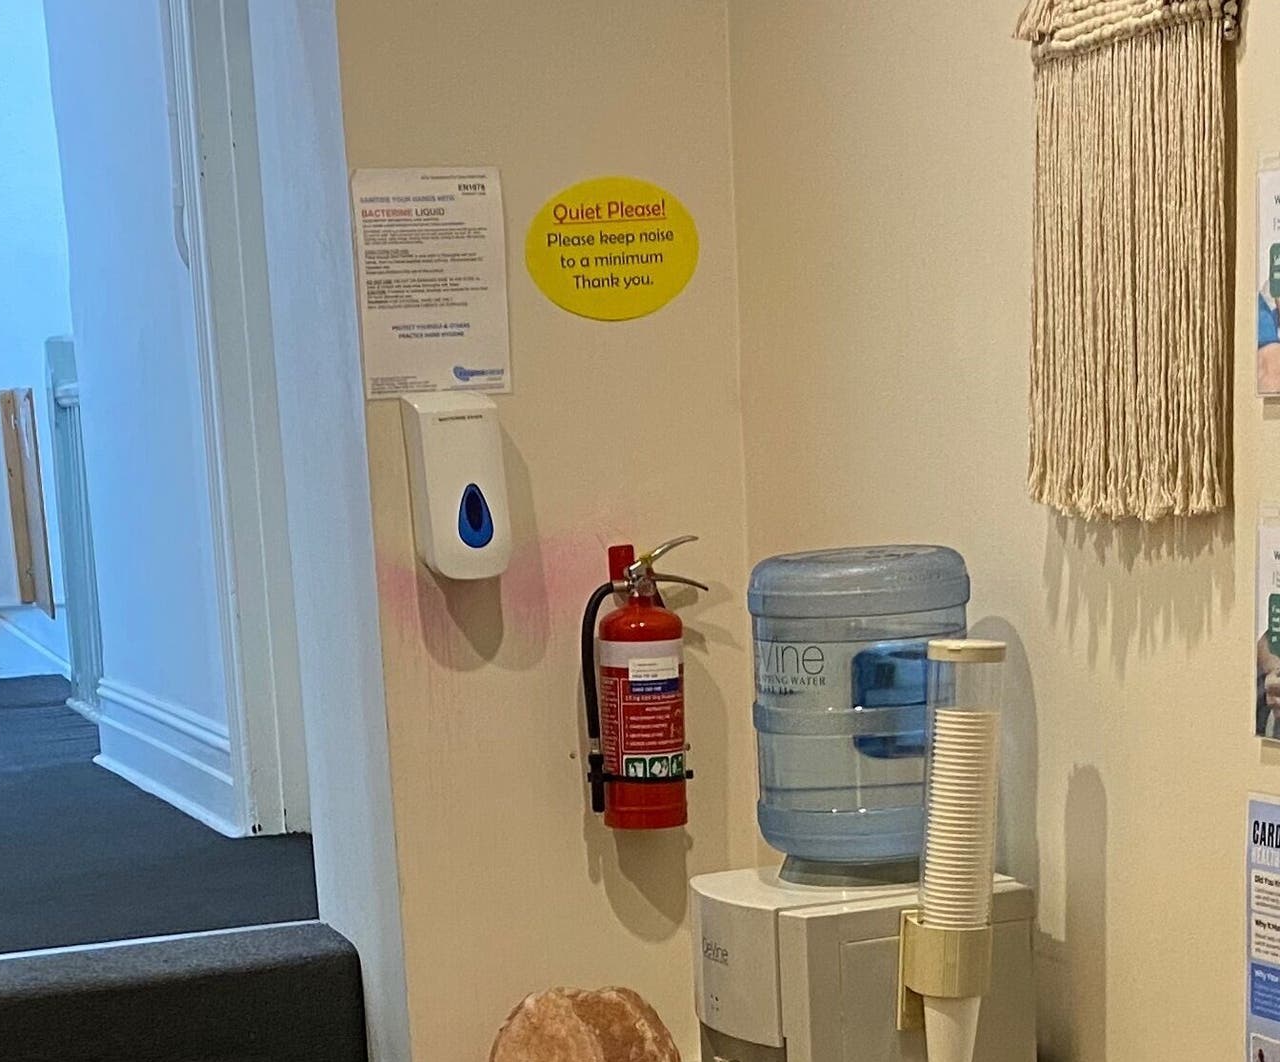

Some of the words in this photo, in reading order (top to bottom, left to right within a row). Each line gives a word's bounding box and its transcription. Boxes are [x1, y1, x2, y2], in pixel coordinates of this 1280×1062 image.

[415, 207, 445, 217] LIQUID
[553, 203, 602, 224] Quiet
[608, 198, 666, 219] Please!
[547, 232, 595, 248] Please
[600, 230, 636, 246] keep
[639, 228, 674, 243] noise
[560, 255, 576, 269] to
[580, 257, 590, 267] a
[595, 251, 664, 267] minimum
[573, 273, 620, 290] Thank
[624, 275, 654, 290] you.
[791, 676, 826, 687] WATER
